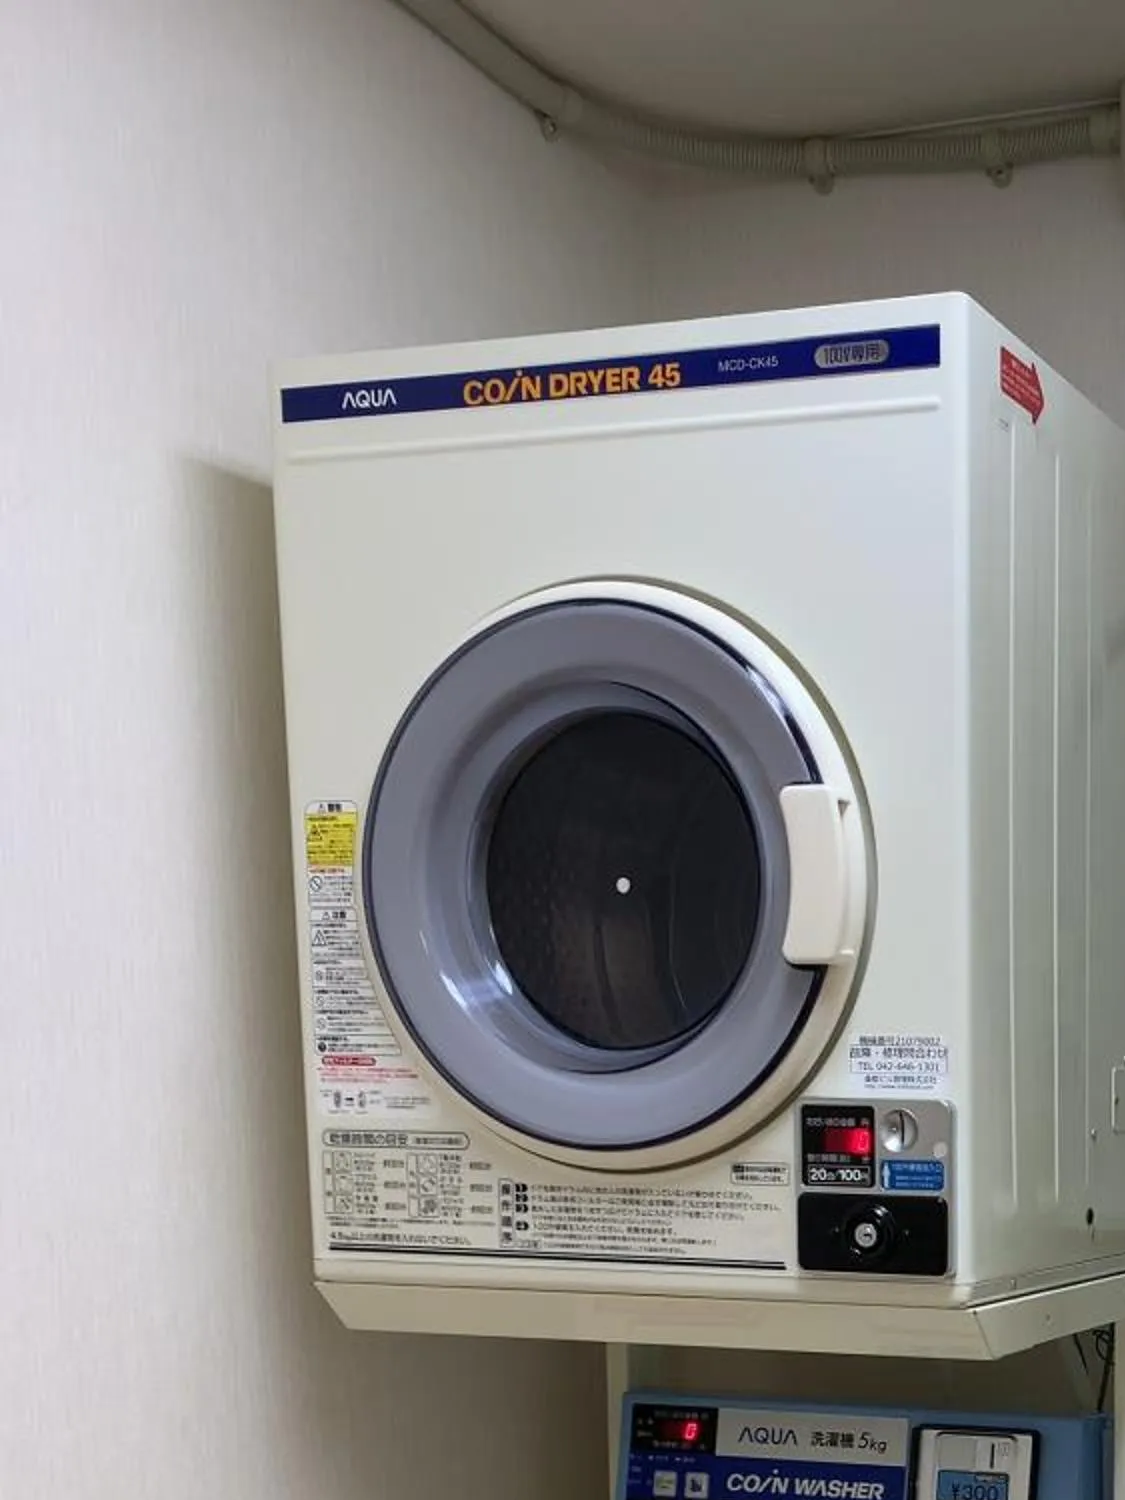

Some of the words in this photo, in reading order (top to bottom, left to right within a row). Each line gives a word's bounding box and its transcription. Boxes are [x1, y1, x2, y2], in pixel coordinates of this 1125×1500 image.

[717, 355, 780, 373] MCD-CK45
[462, 369, 542, 406] COIN
[548, 366, 641, 398] DRYER
[647, 361, 682, 388] 45
[341, 387, 398, 410] AQUA
[738, 1426, 799, 1446] AQUA
[811, 1431, 855, 1449] 洗濯機
[858, 1431, 888, 1454] 5kg
[727, 1468, 789, 1495] COIN
[794, 1477, 885, 1500] WASHER
